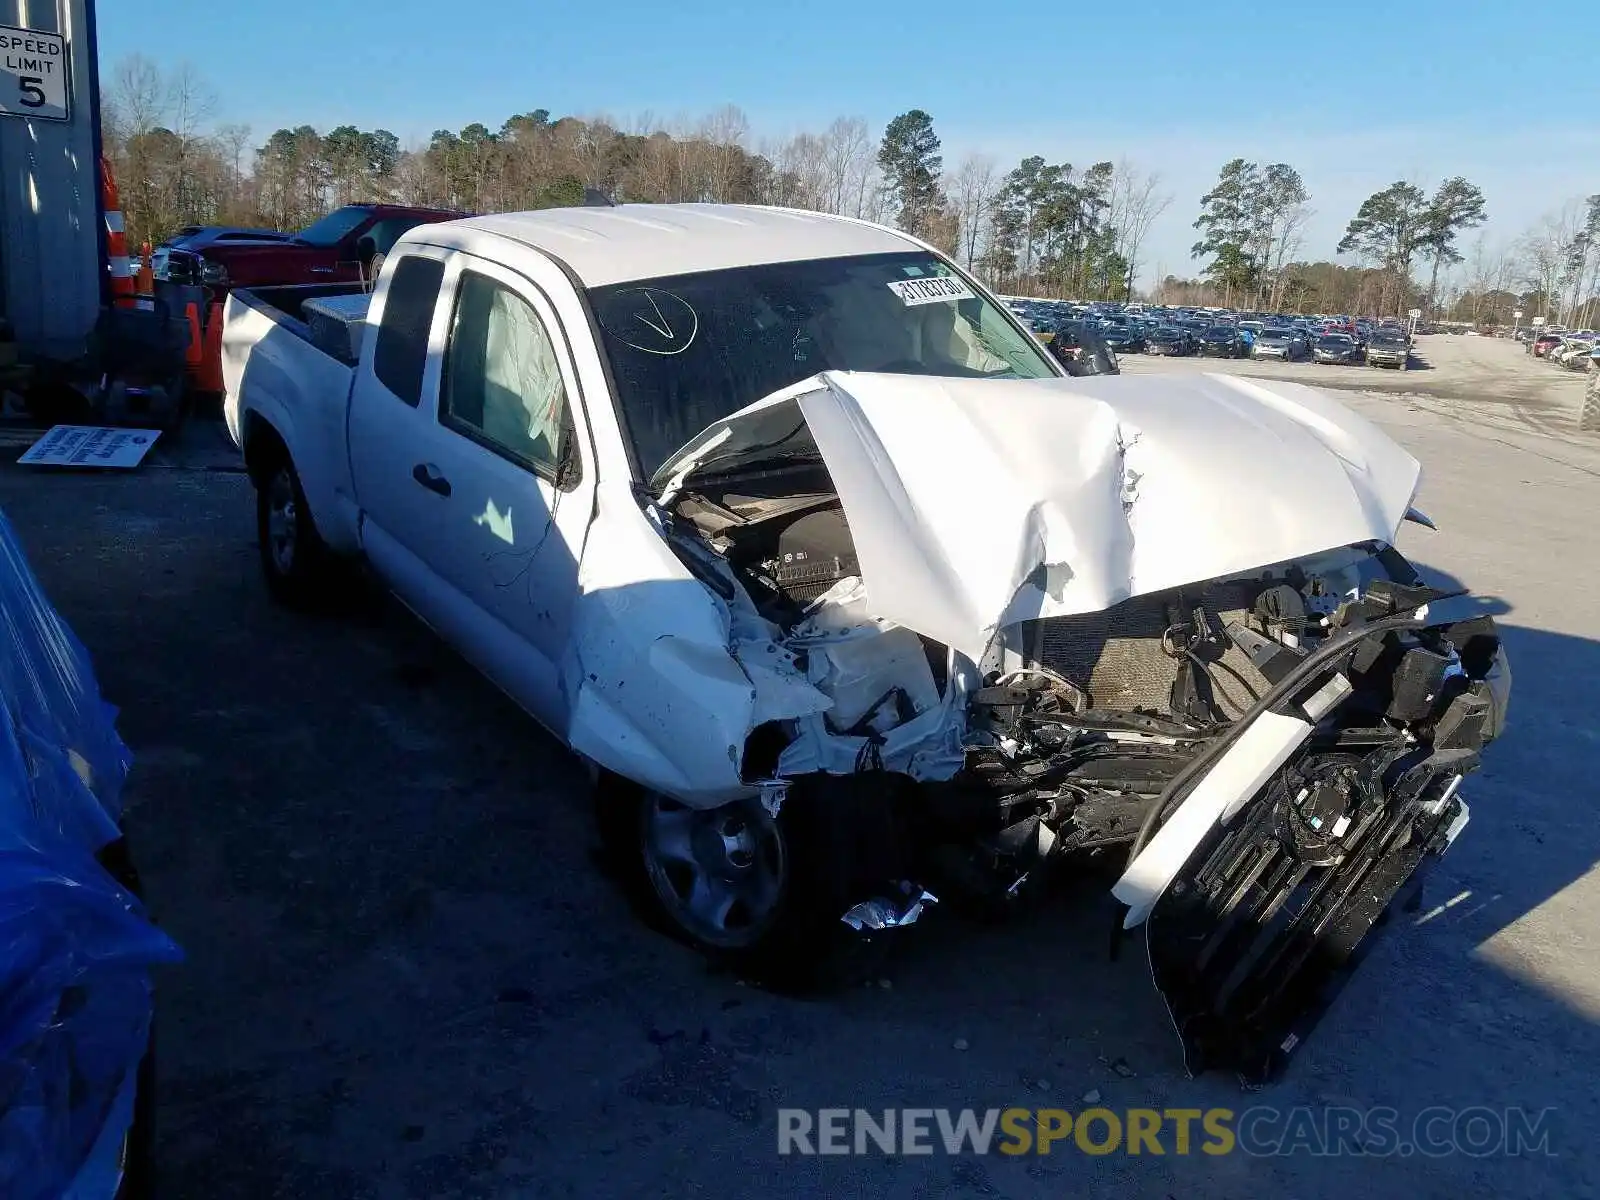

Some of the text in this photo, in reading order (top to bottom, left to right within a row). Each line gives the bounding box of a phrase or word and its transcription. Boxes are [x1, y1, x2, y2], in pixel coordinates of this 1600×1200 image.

[0, 36, 60, 55] SPEED
[7, 55, 54, 73] LIMIT
[19, 76, 46, 107] 5
[898, 278, 962, 300] 31783730
